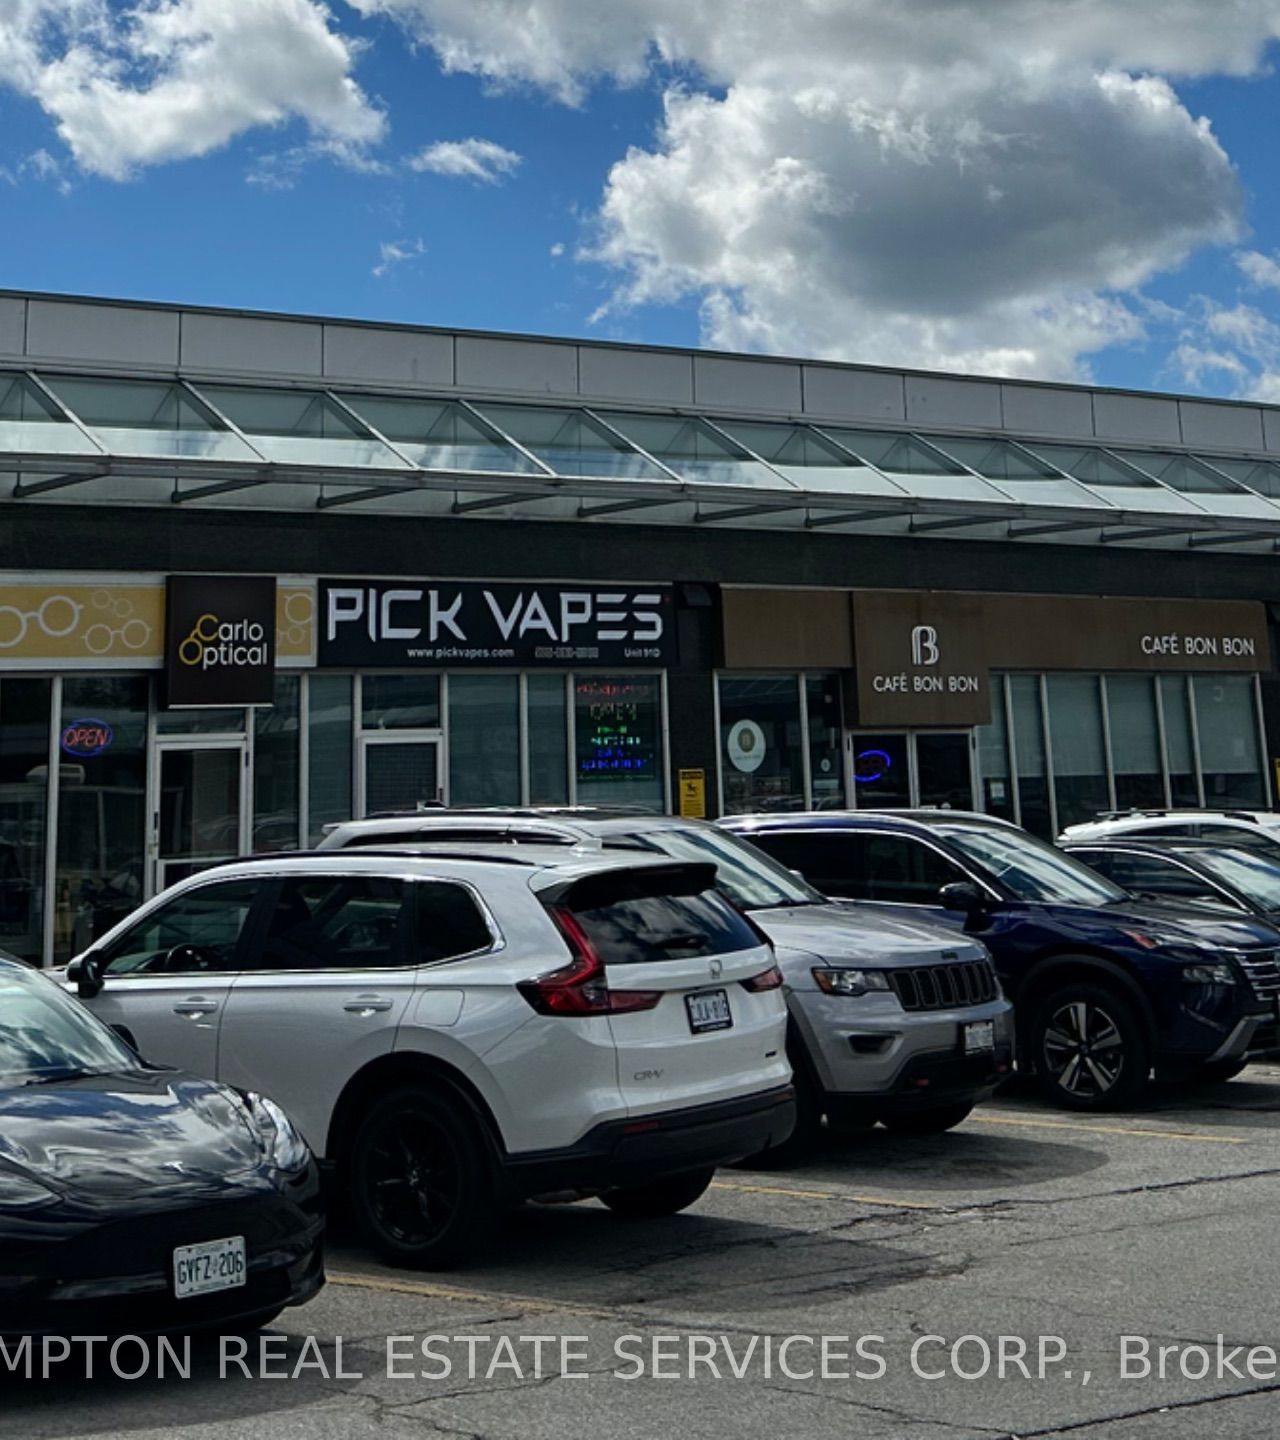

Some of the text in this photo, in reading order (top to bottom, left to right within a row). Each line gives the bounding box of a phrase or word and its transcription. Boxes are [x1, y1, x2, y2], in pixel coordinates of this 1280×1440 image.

[197, 614, 264, 642] Carlo
[327, 588, 664, 643] PICK VAPES
[178, 637, 268, 670] Optical
[407, 646, 515, 660] www.pickvapes.com
[1141, 633, 1255, 657] CAFÉ BON BON
[873, 673, 978, 693] CAFÉ BON BON
